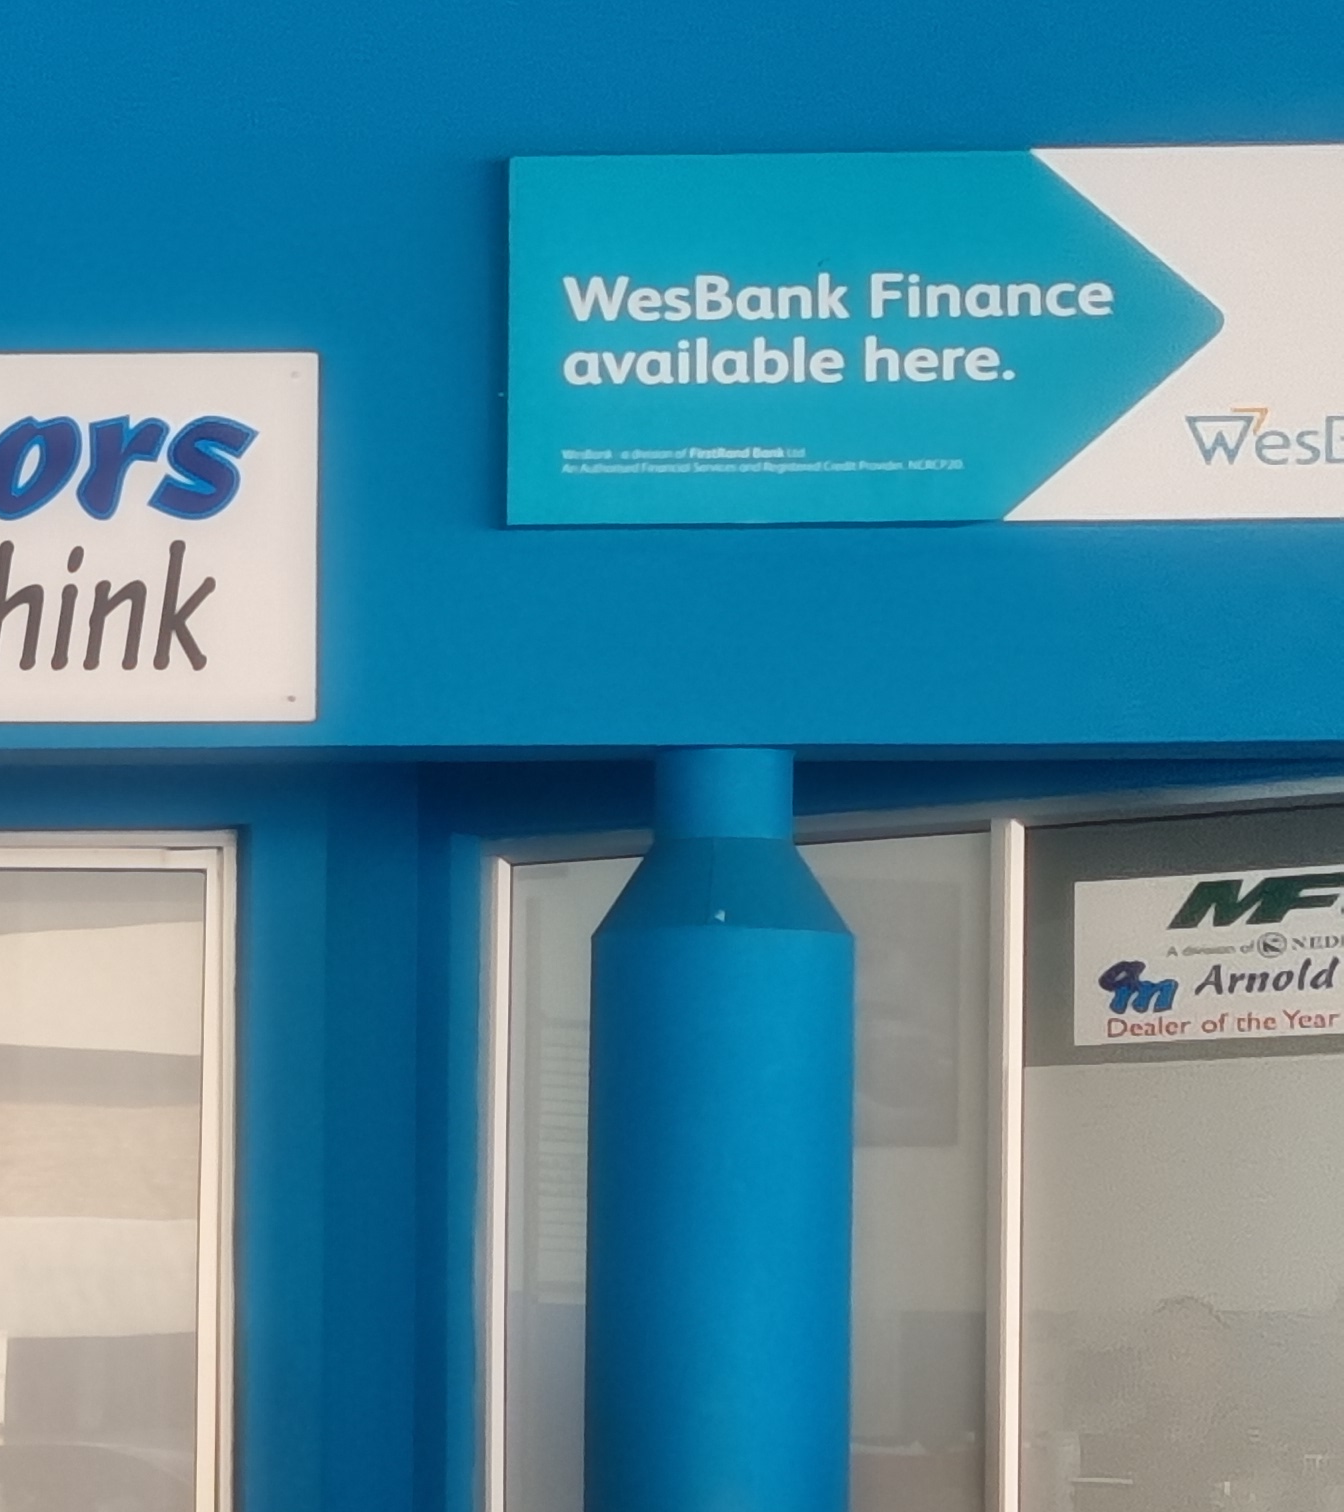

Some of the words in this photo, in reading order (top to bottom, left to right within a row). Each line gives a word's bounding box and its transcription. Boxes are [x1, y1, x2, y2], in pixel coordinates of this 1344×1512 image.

[562, 273, 850, 322] WesBank
[870, 270, 1114, 318] Finance
[562, 336, 845, 386] available
[864, 336, 1016, 382] here.
[1166, 871, 1344, 930] MF
[1292, 934, 1344, 950] NED
[1194, 955, 1340, 996] Arnold
[1107, 1016, 1192, 1038] Dealer
[1201, 1012, 1229, 1034] of
[1237, 1010, 1277, 1031] the
[1283, 1009, 1341, 1030] Year
